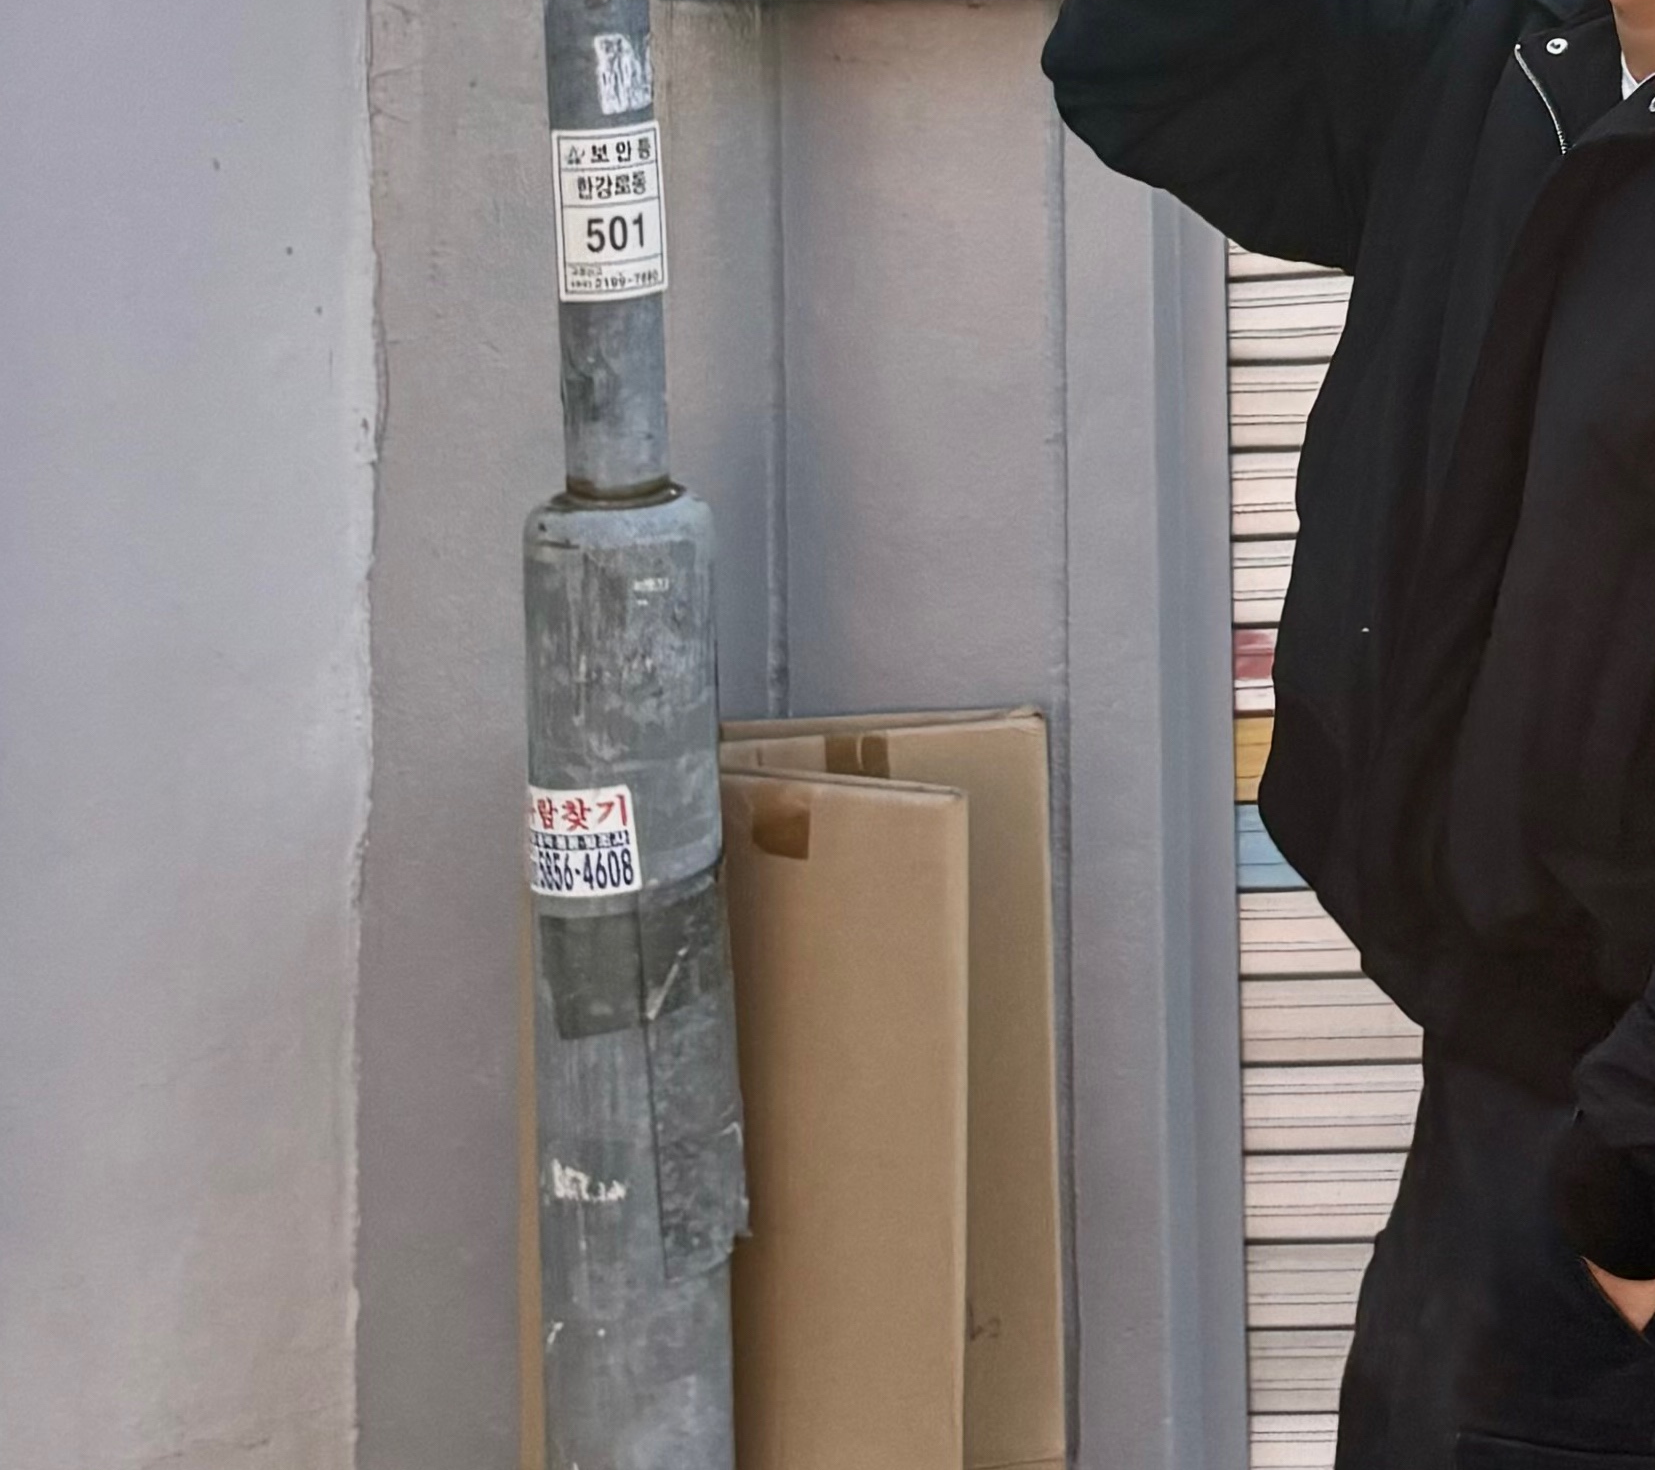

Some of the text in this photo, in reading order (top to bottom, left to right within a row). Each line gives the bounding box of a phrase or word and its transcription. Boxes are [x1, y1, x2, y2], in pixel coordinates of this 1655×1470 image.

[591, 138, 652, 163] 보안등
[578, 171, 647, 200] 한강로동
[587, 213, 645, 253] 501
